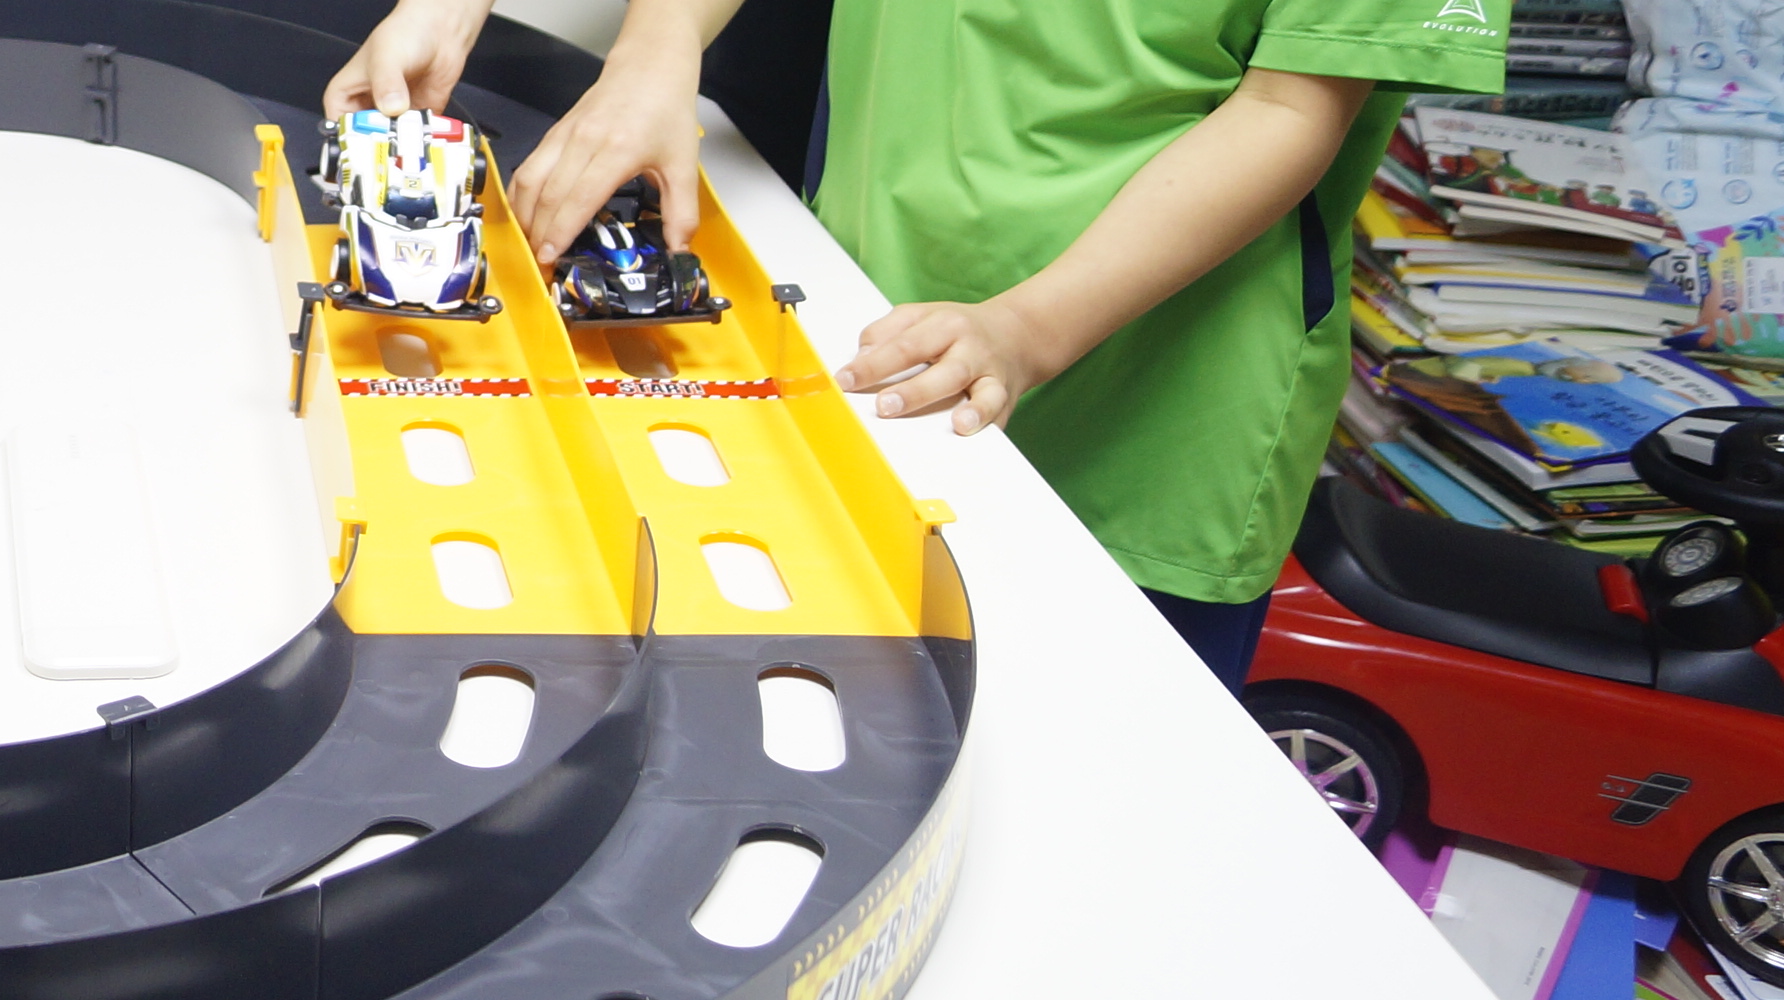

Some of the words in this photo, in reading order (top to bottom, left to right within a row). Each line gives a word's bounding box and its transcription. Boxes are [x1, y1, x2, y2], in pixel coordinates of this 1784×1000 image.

[1422, 21, 1498, 37] EVOLUTION
[627, 276, 642, 286] 01
[368, 381, 463, 394] FINISH!
[617, 382, 706, 395] START!
